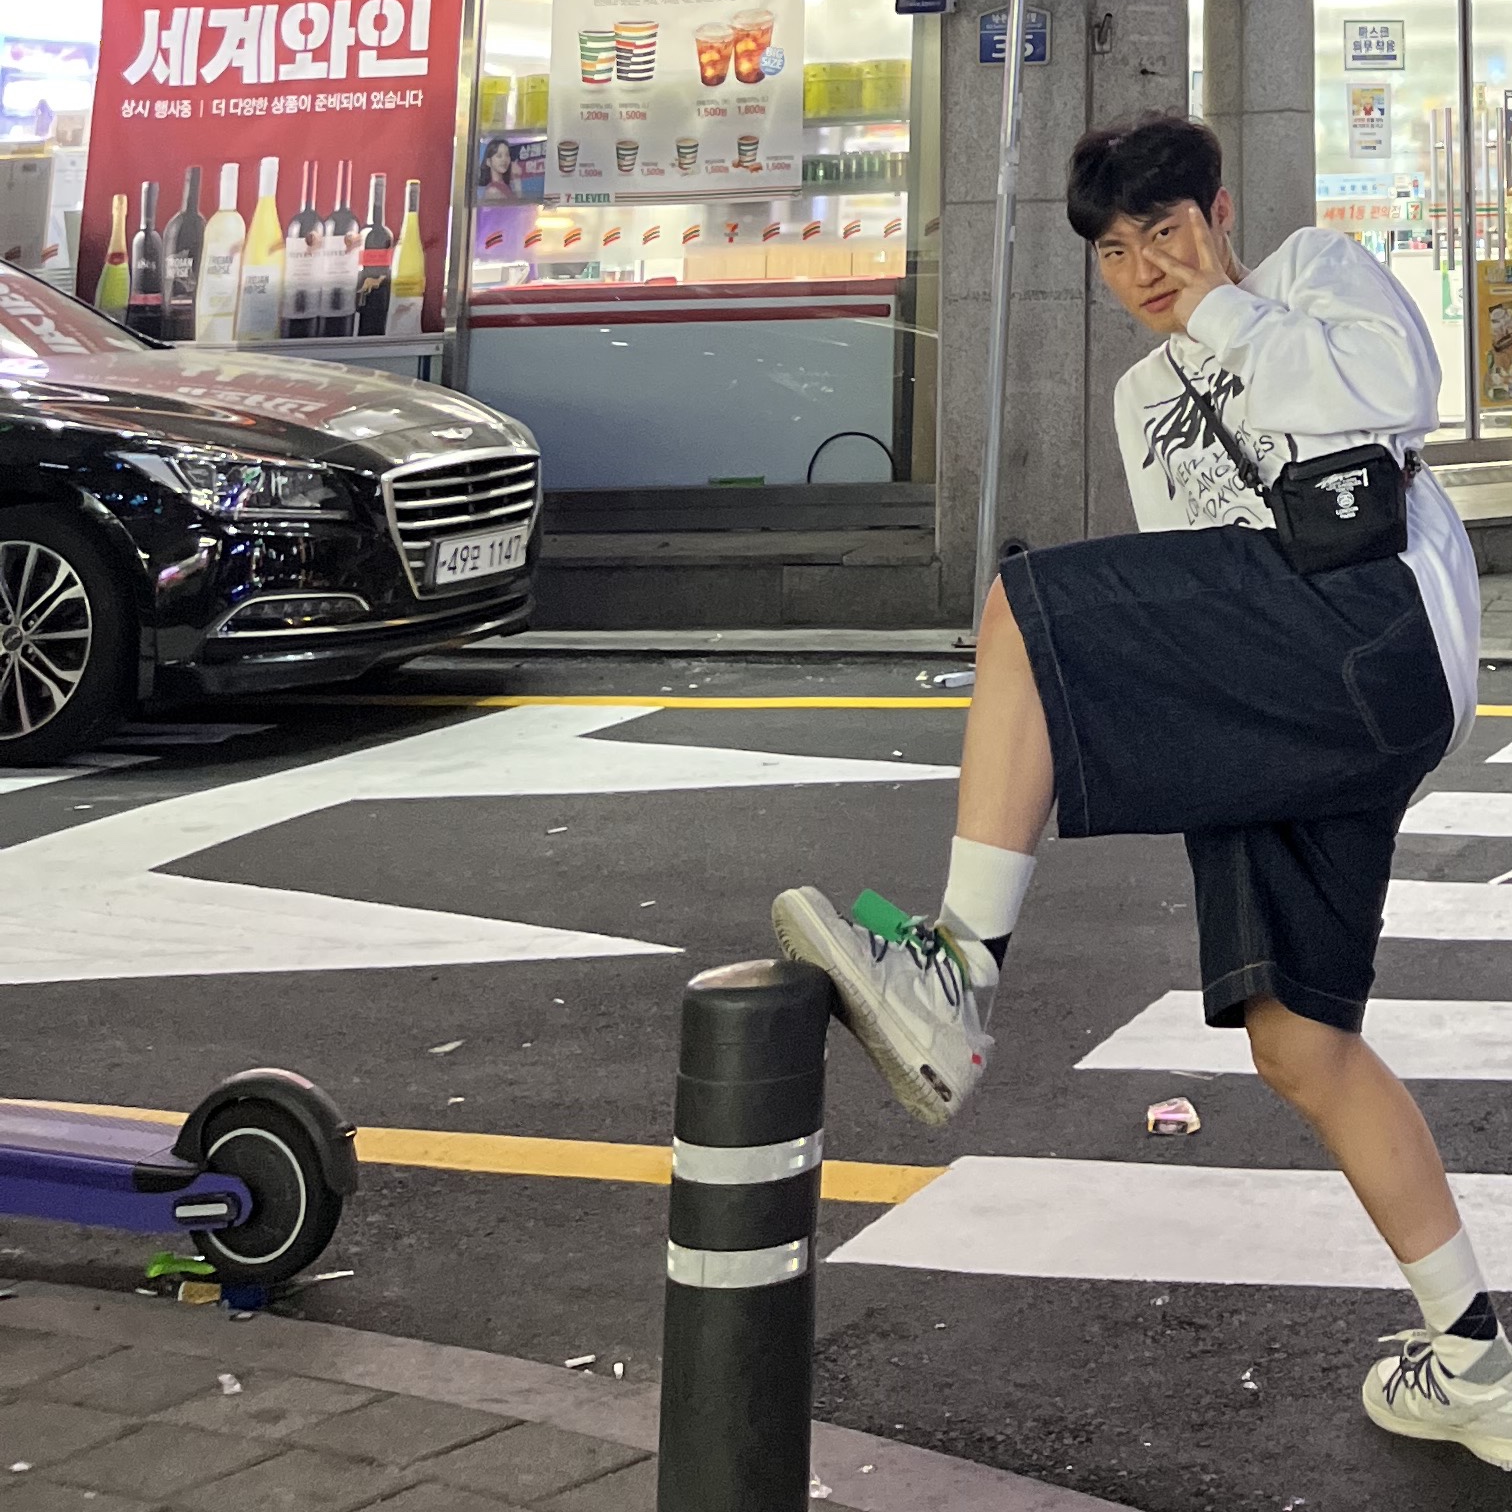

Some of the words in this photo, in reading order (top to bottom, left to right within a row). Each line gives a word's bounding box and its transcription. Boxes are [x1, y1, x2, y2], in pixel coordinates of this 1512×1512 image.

[121, 99, 150, 118] 상시
[211, 99, 225, 117] 더
[229, 97, 268, 116] 다양한
[271, 94, 311, 115] 상품이
[314, 92, 366, 113] 준비되어
[370, 89, 423, 110] 있습니다
[489, 535, 521, 567] 1147
